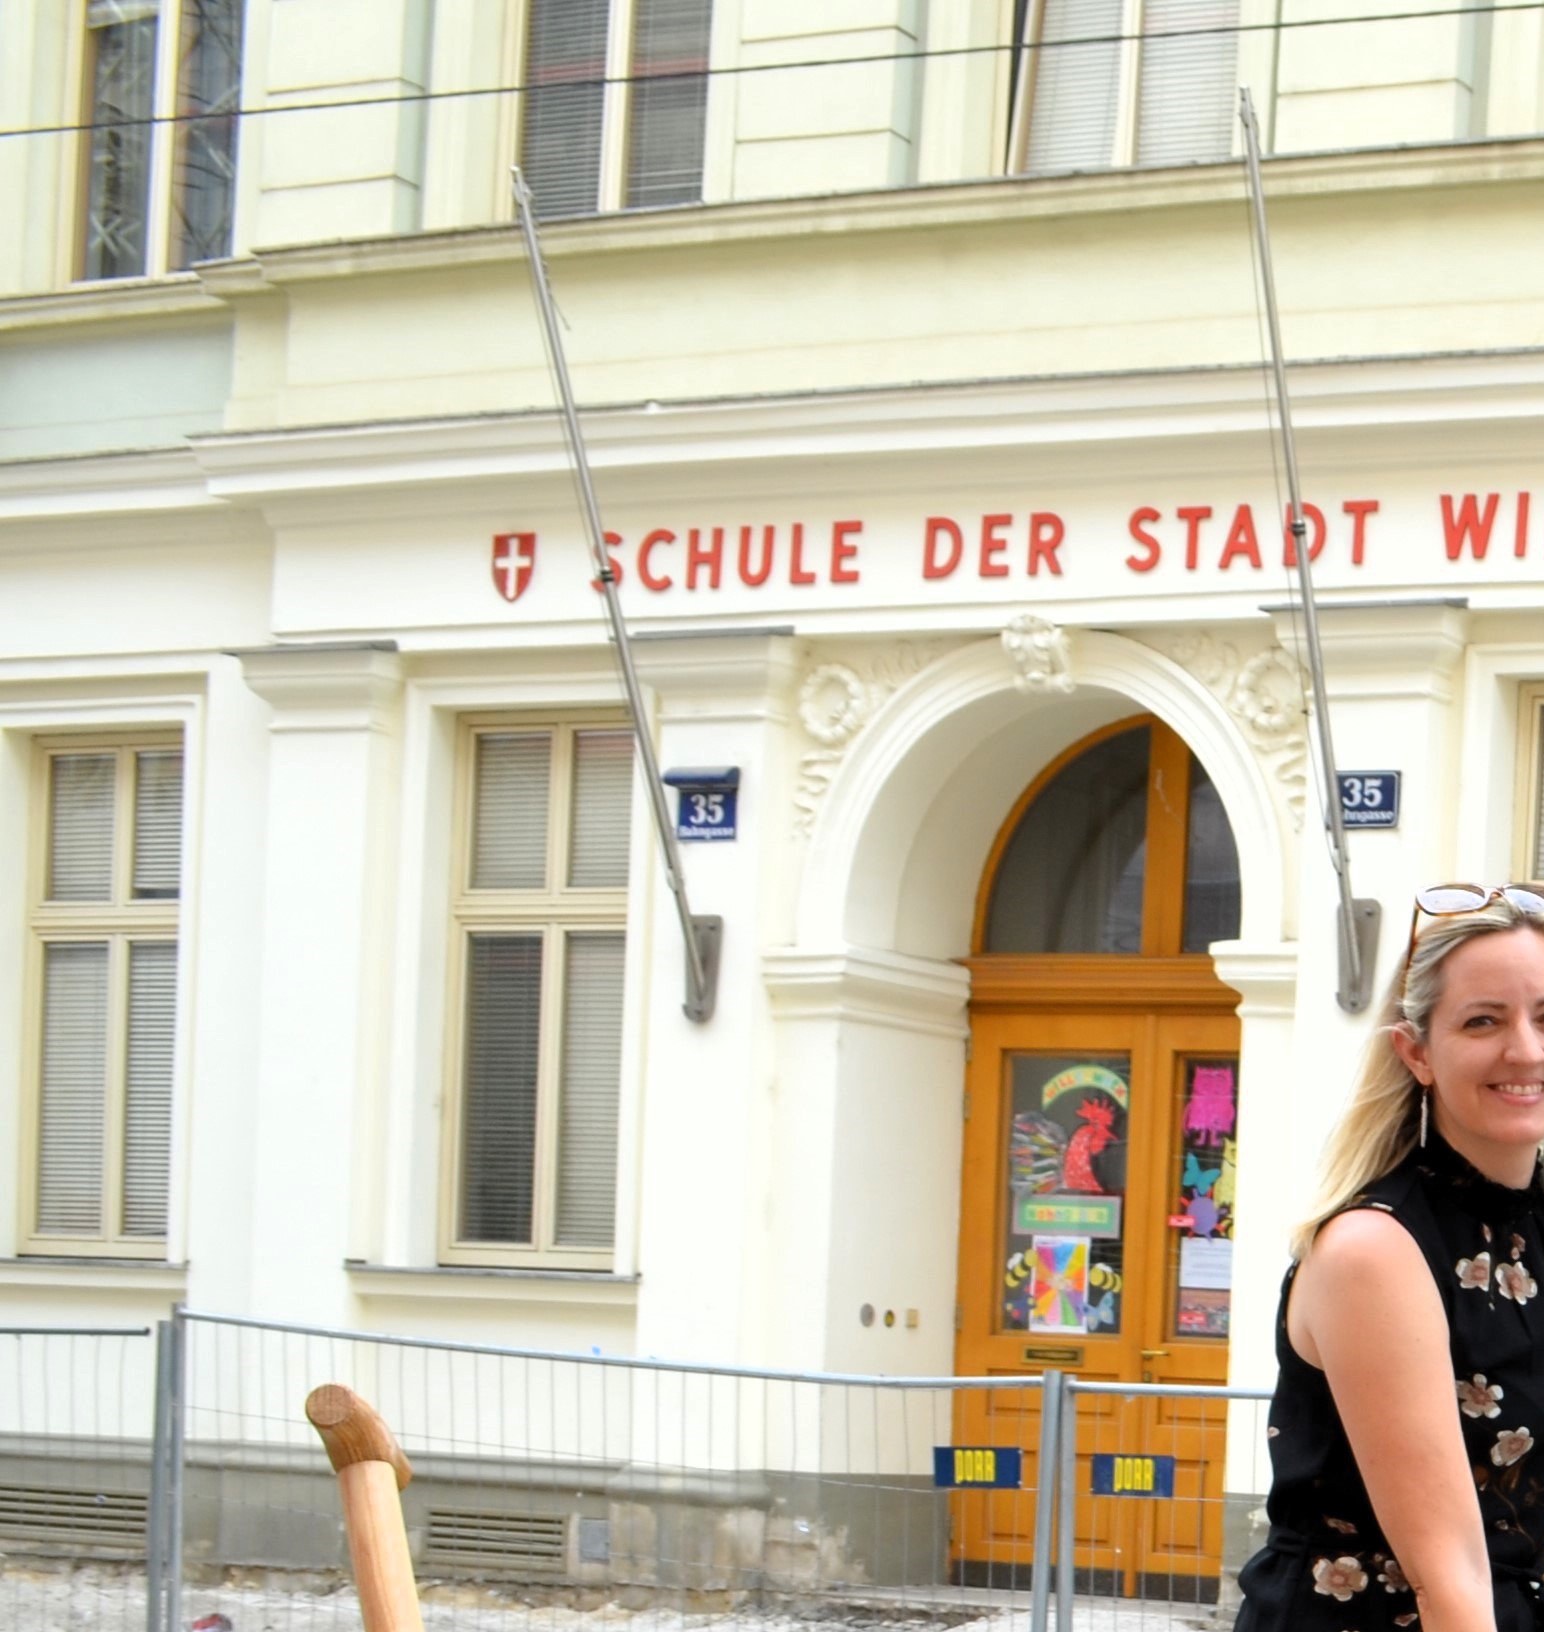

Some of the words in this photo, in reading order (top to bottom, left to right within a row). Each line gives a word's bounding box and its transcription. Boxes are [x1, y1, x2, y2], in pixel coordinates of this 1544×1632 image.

[590, 520, 863, 594] SCHULE
[923, 512, 1066, 580] DER
[1126, 500, 1379, 573] STADT
[1342, 778, 1382, 807] 35
[689, 794, 725, 825] 35
[1343, 809, 1394, 822] hngasse
[954, 1449, 996, 1483] PORR
[1114, 1457, 1154, 1492] PORR
